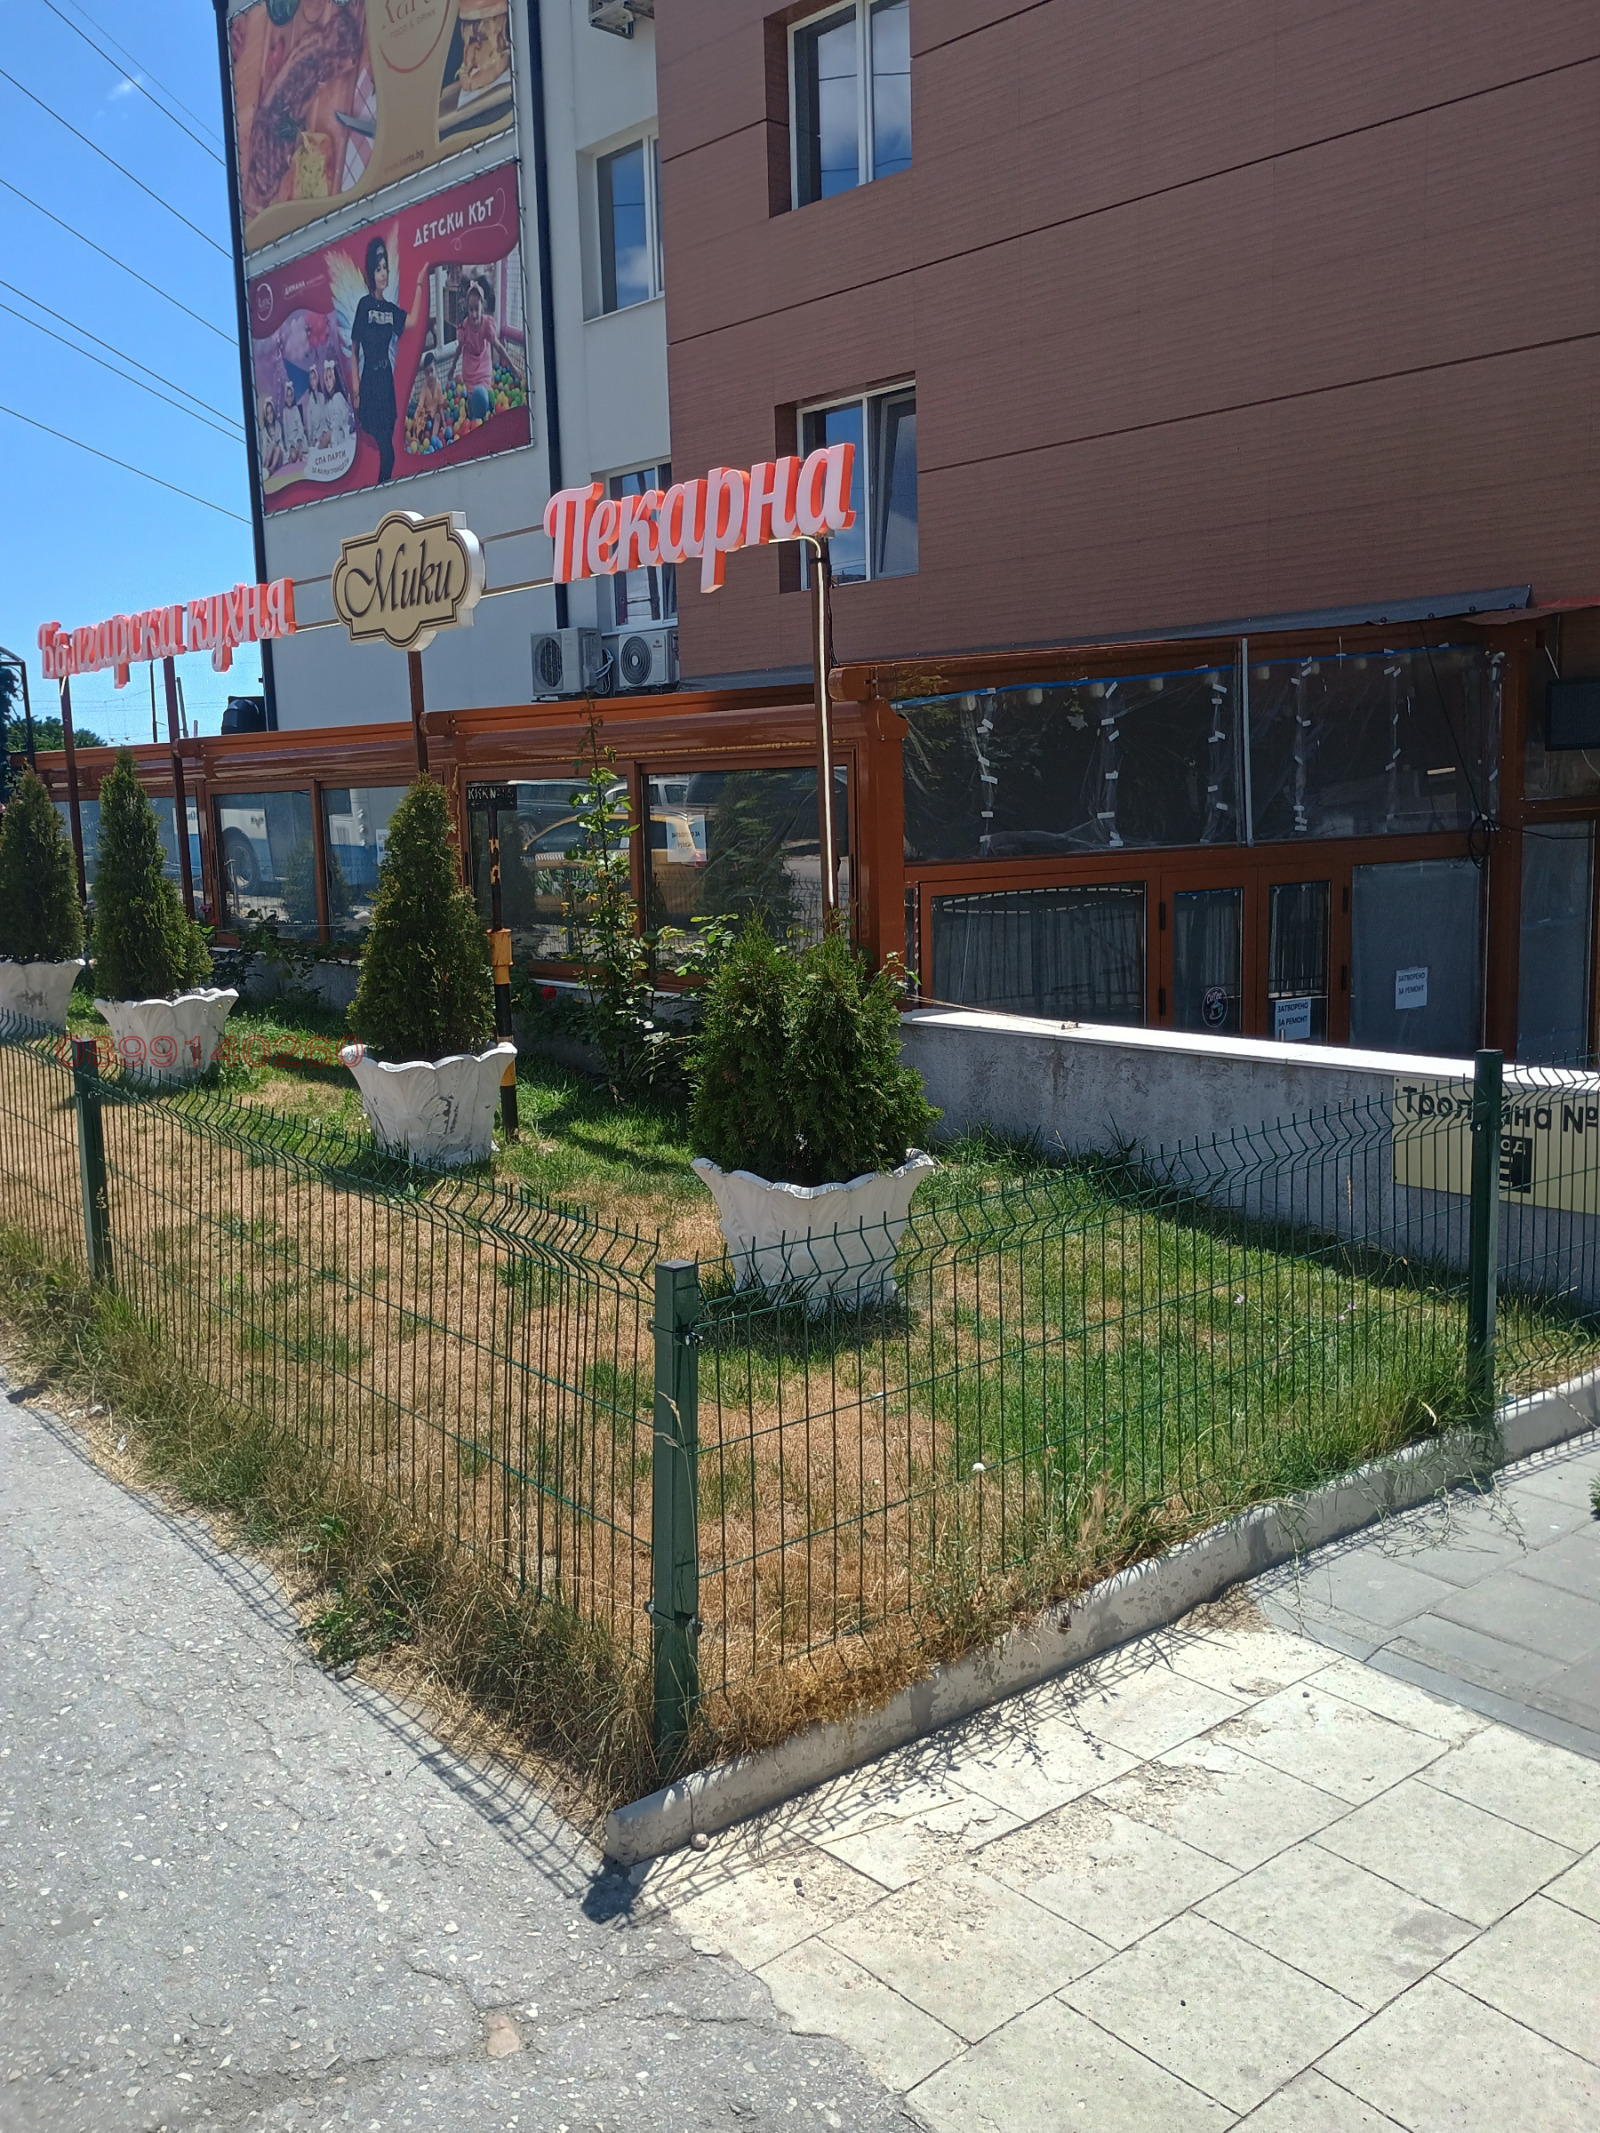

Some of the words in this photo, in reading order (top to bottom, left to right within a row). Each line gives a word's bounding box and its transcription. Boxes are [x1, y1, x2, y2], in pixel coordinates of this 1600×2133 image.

[413, 211, 463, 248] ДЕТСКИ
[468, 196, 495, 226] КЪТ
[543, 443, 857, 594] Пекарна
[37, 604, 187, 689] Българска
[186, 577, 297, 673] кухня
[1277, 1002, 1309, 1013] ЗАТВОРЕНО
[1286, 1015, 1308, 1025] РЕМОНТ
[1402, 1086, 1552, 1130] Тролйна
